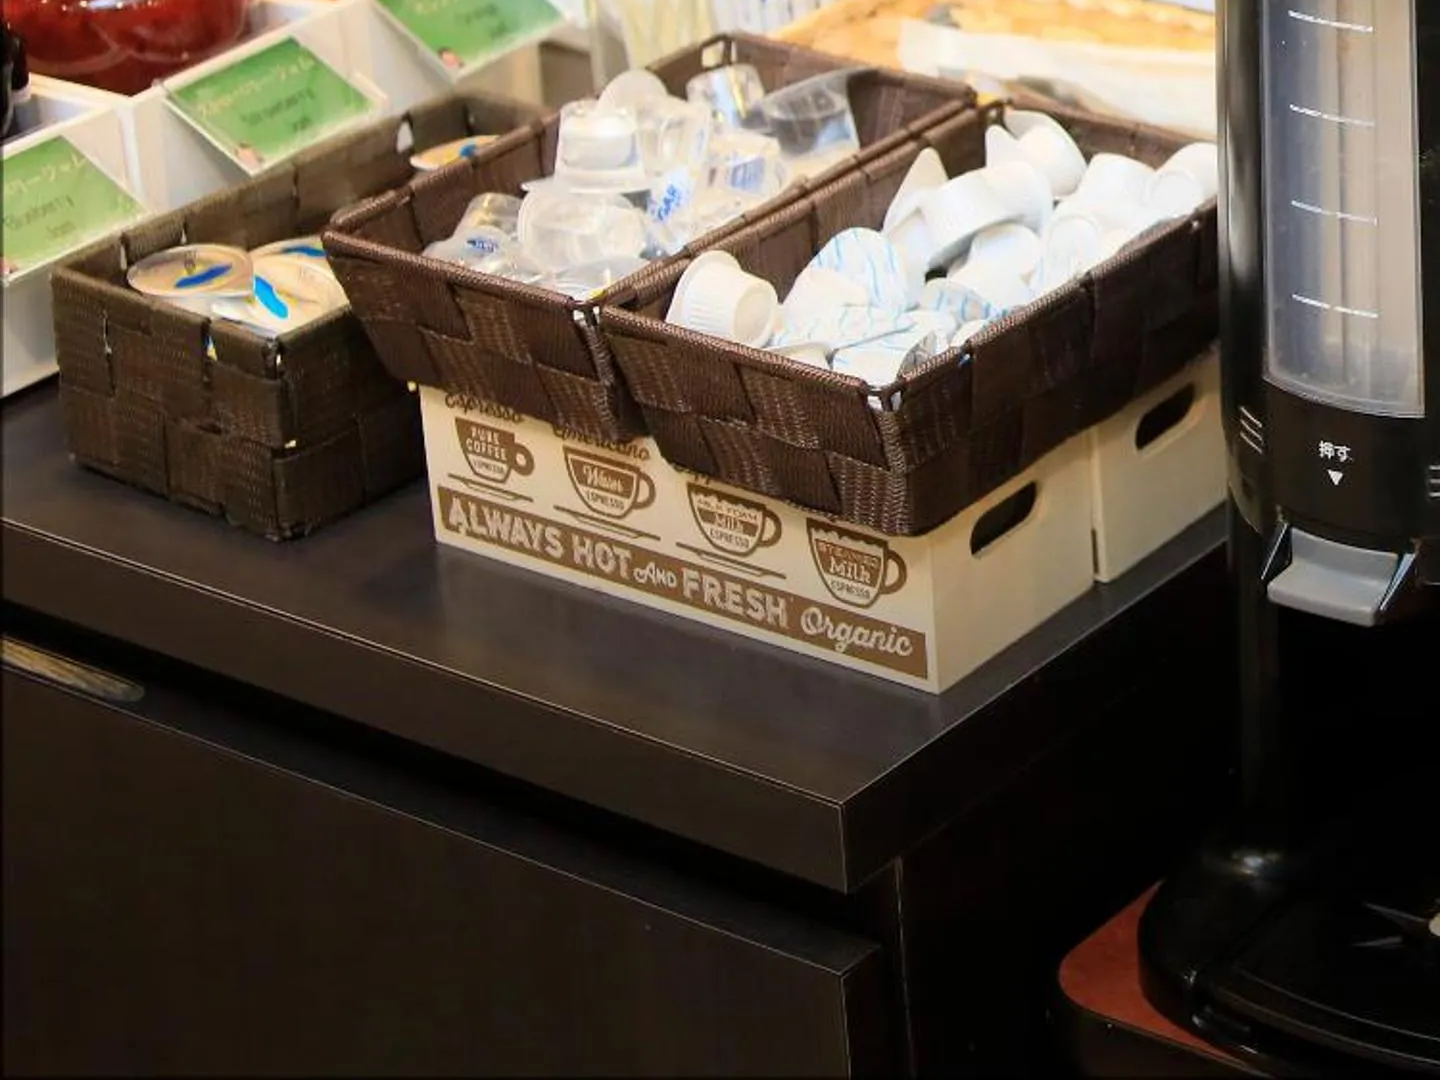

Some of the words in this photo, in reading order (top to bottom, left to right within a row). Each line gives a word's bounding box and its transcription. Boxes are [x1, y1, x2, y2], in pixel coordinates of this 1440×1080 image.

[470, 425, 501, 446] PURE
[465, 438, 508, 462] COFFEE
[1318, 439, 1353, 462] 押す
[449, 496, 565, 560] ALWAYS
[571, 532, 633, 580] HOT
[681, 566, 790, 630] FRESH
[799, 606, 914, 658] Organic
[829, 556, 872, 585] Milk
